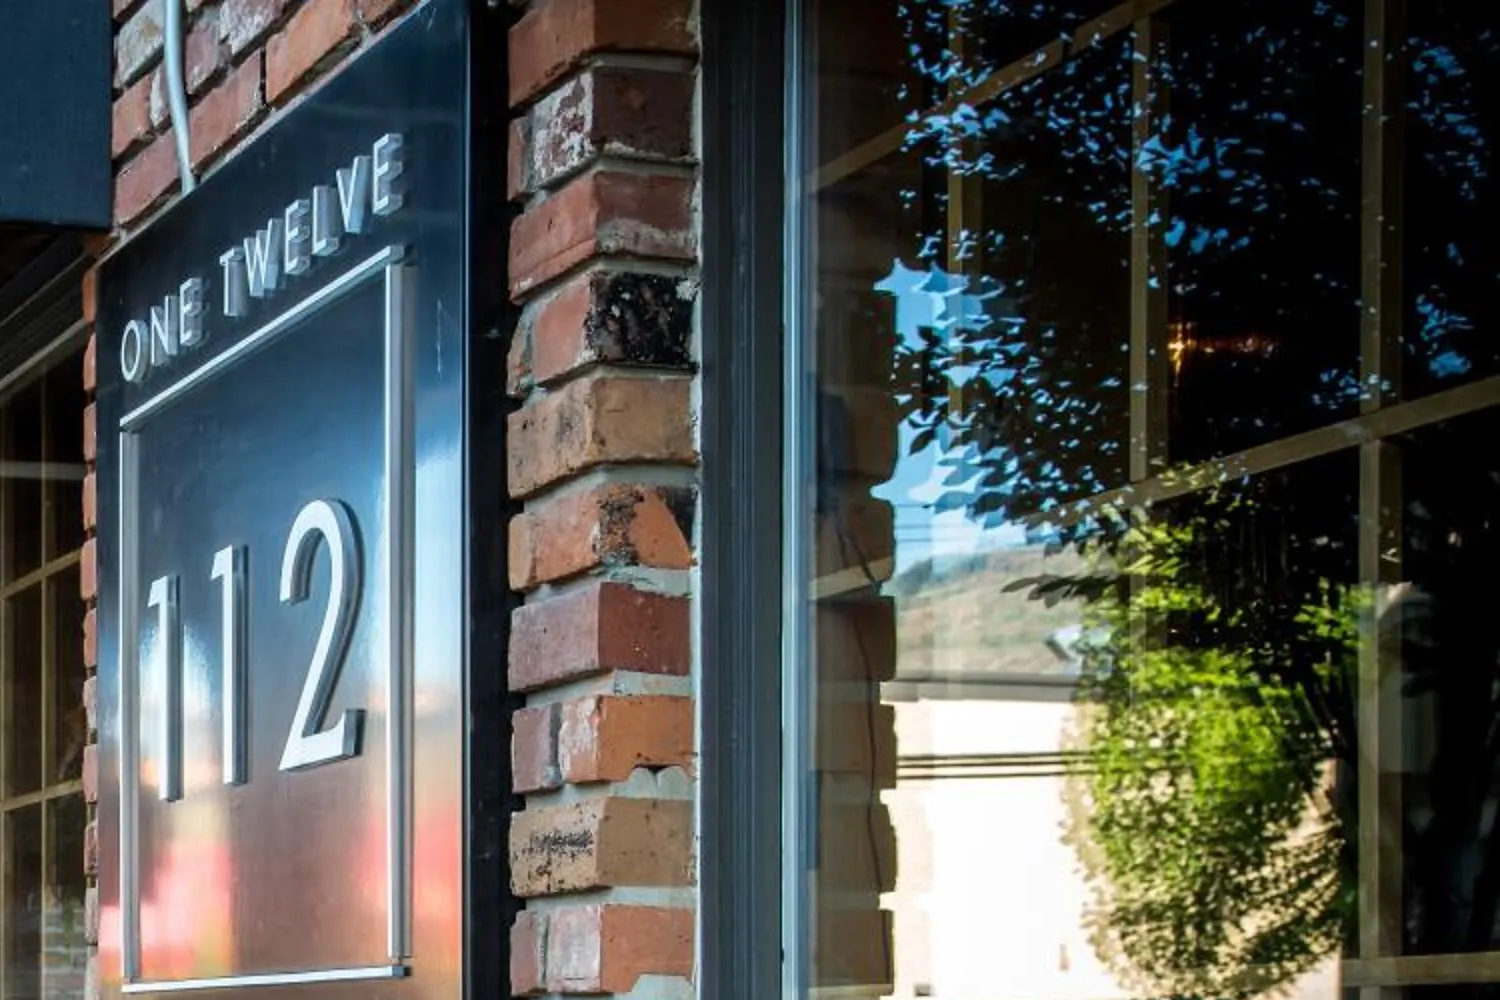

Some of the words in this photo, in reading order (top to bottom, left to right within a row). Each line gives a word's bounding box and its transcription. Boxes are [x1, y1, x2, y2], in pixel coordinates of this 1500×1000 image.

[121, 277, 202, 383] ONE
[220, 133, 404, 317] TWELVE
[147, 497, 367, 803] 112
